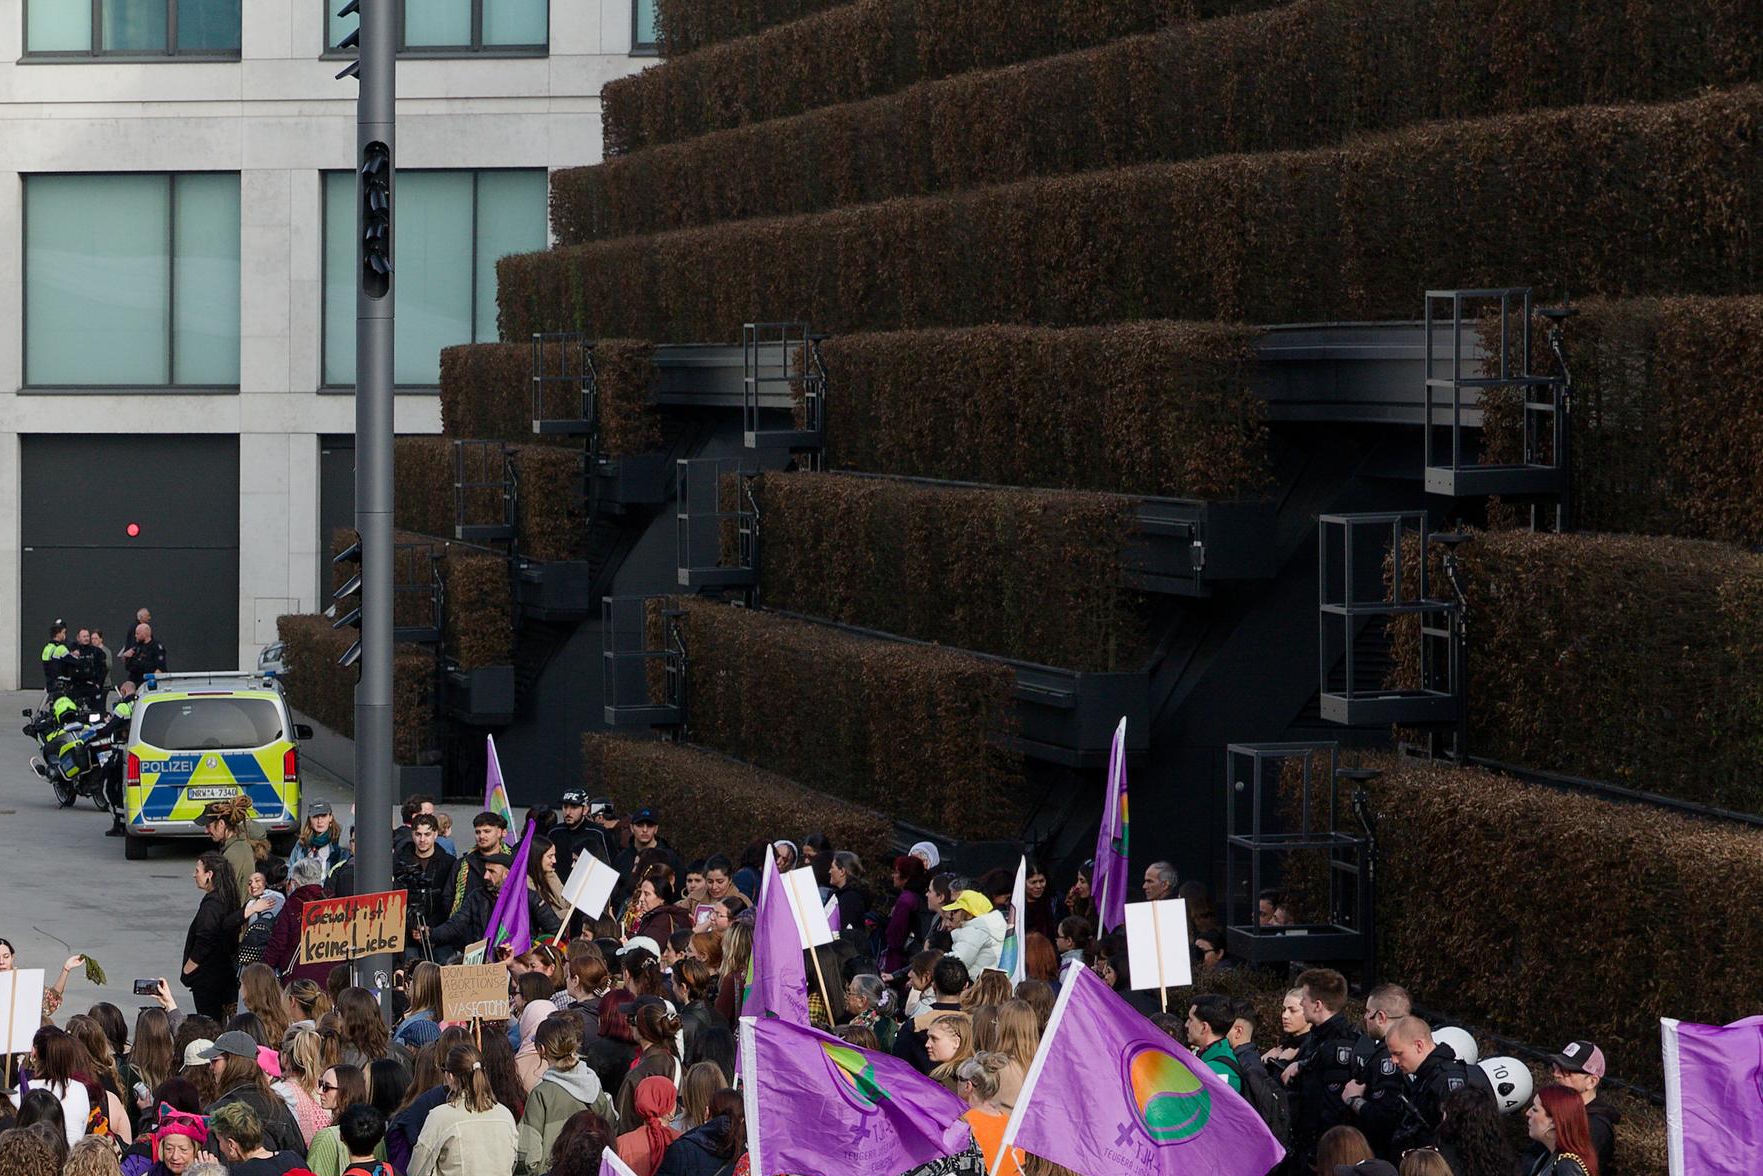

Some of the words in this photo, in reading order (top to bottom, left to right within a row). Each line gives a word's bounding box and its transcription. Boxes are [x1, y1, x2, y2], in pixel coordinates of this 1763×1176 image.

[142, 761, 193, 772] POLIZEI
[306, 900, 360, 926] Gewalt
[363, 899, 384, 920] ist
[305, 930, 349, 961] keine
[352, 922, 398, 957] Liebe
[476, 966, 500, 977] LIKE
[443, 976, 507, 991] ABORTIONS?
[447, 1000, 508, 1017] VASECTOMY
[1493, 1065, 1508, 1079] 10
